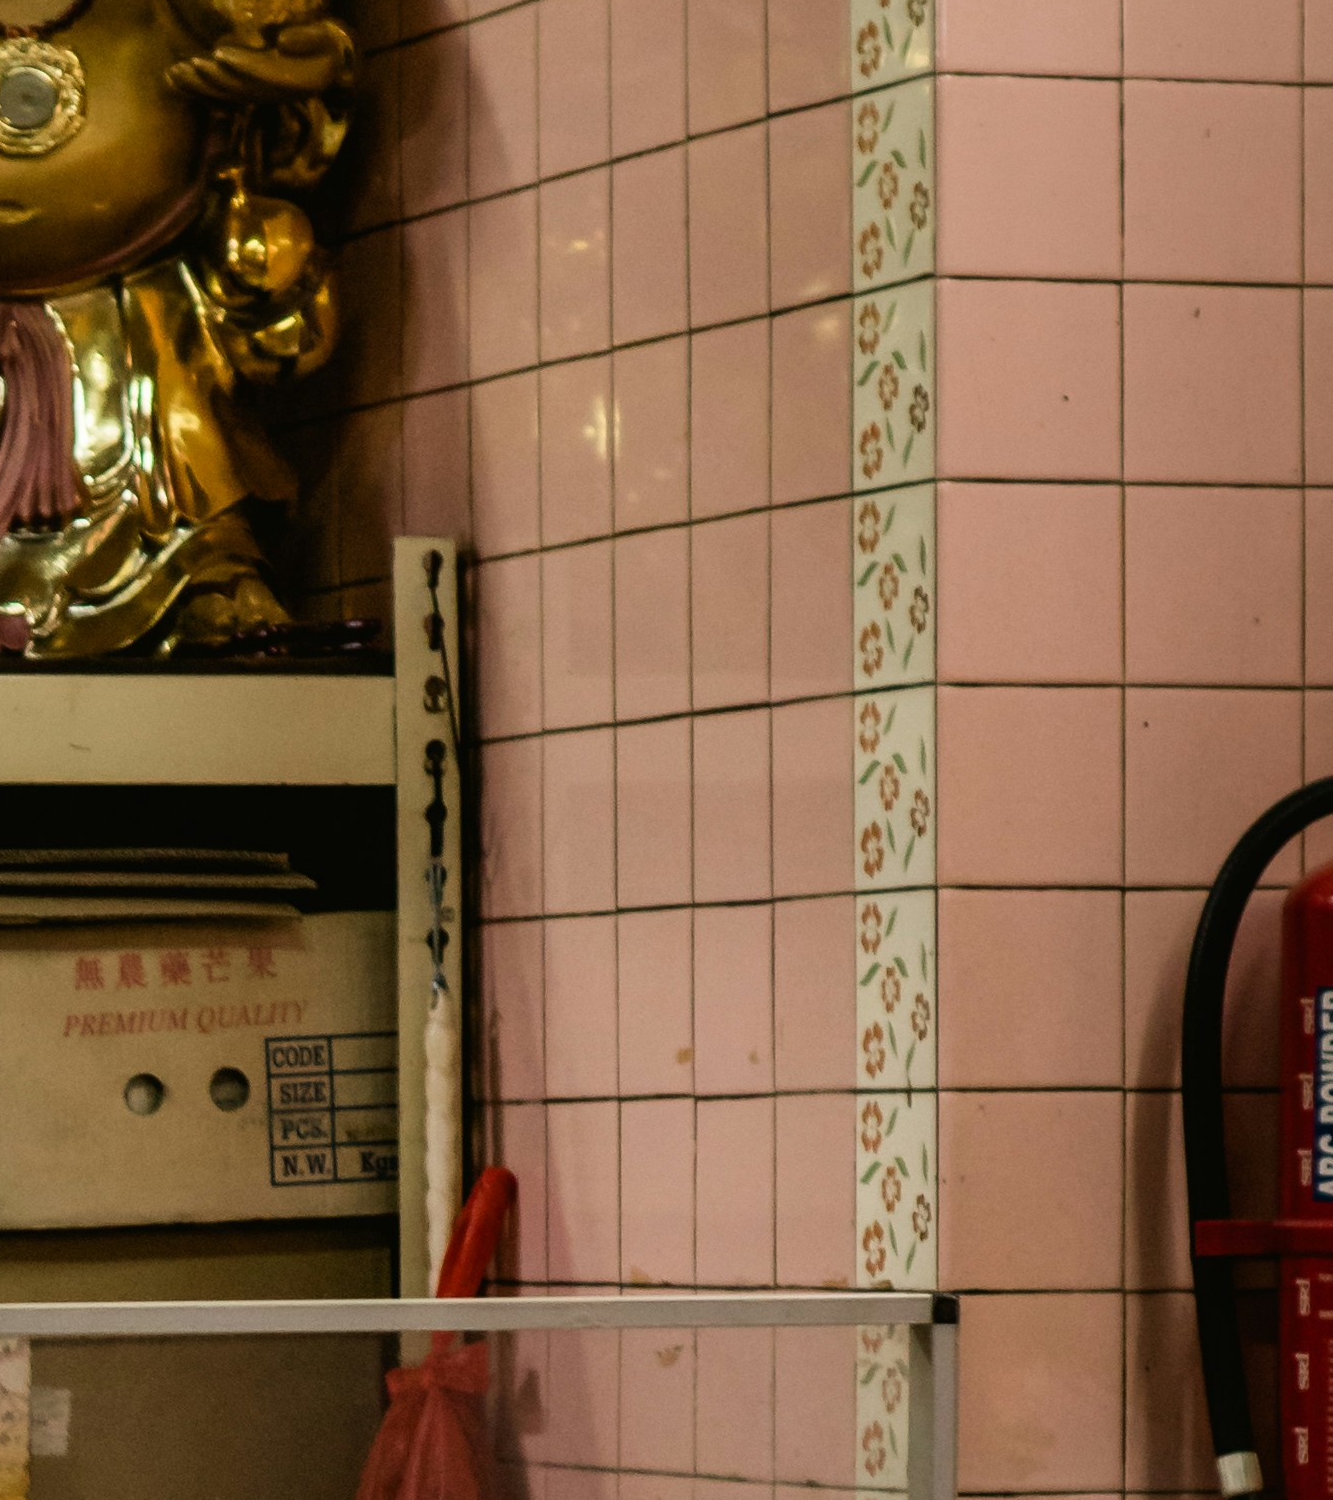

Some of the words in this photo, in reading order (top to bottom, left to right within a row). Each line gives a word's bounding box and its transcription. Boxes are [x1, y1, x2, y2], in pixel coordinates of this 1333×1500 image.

[62, 1007, 190, 1038] PREMIUM
[195, 1001, 306, 1035] QUALITY
[271, 1045, 327, 1068] CODE
[279, 1081, 328, 1104] SIZE
